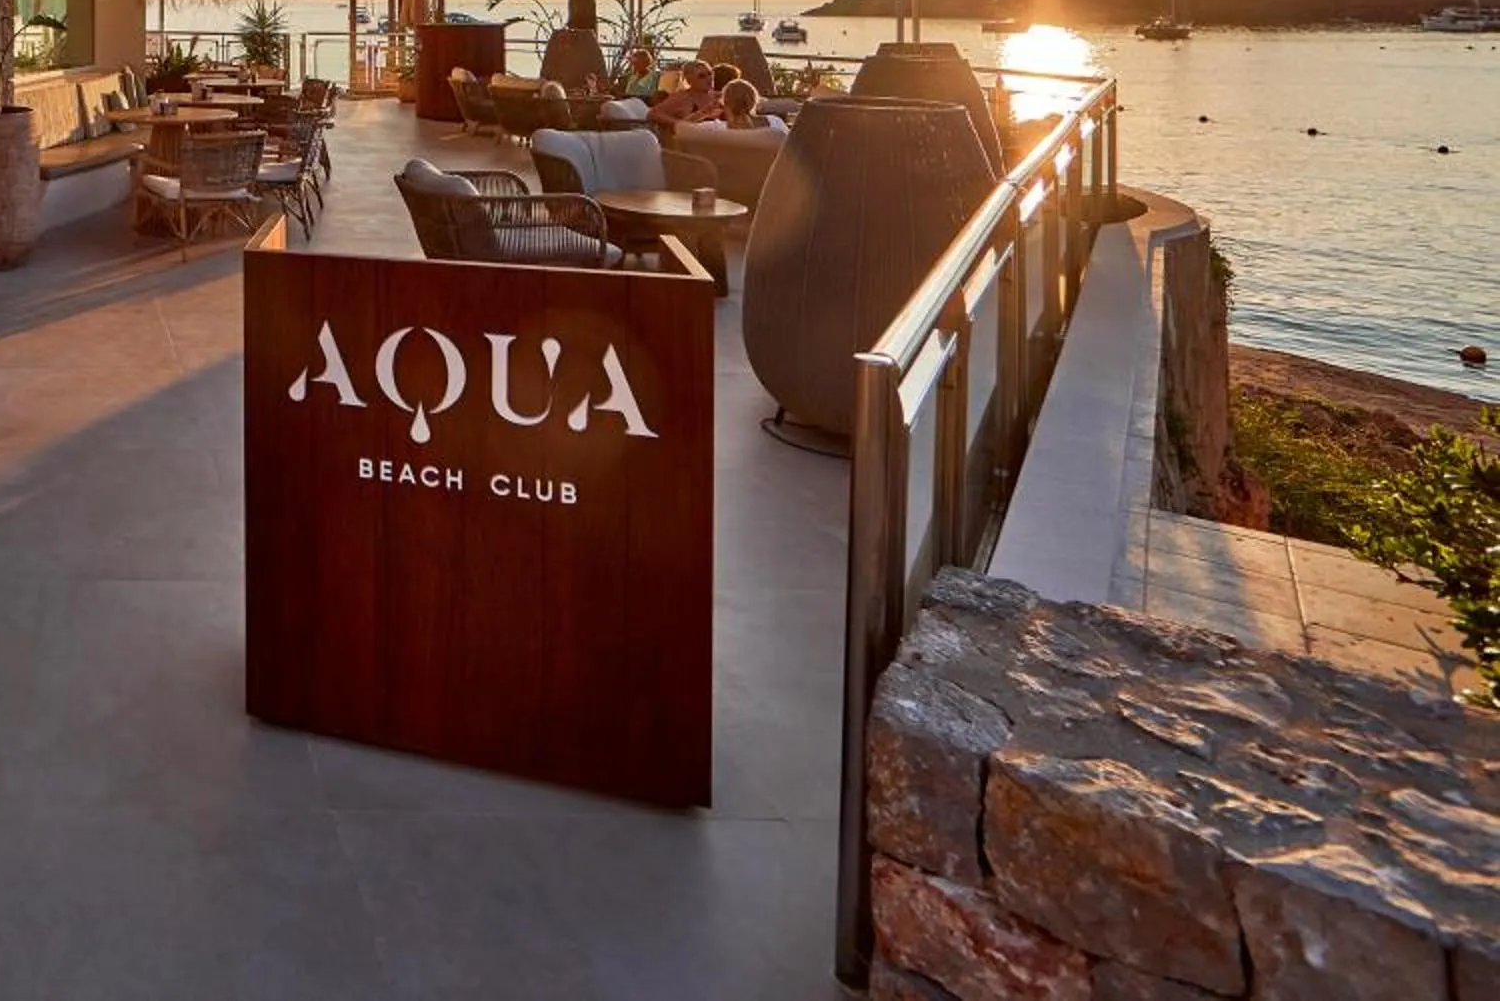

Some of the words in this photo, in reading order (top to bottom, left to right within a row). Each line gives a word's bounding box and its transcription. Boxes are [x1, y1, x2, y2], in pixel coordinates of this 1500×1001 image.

[288, 320, 659, 444] AQUA
[358, 458, 464, 491] BEACH
[489, 475, 578, 505] CLUB
